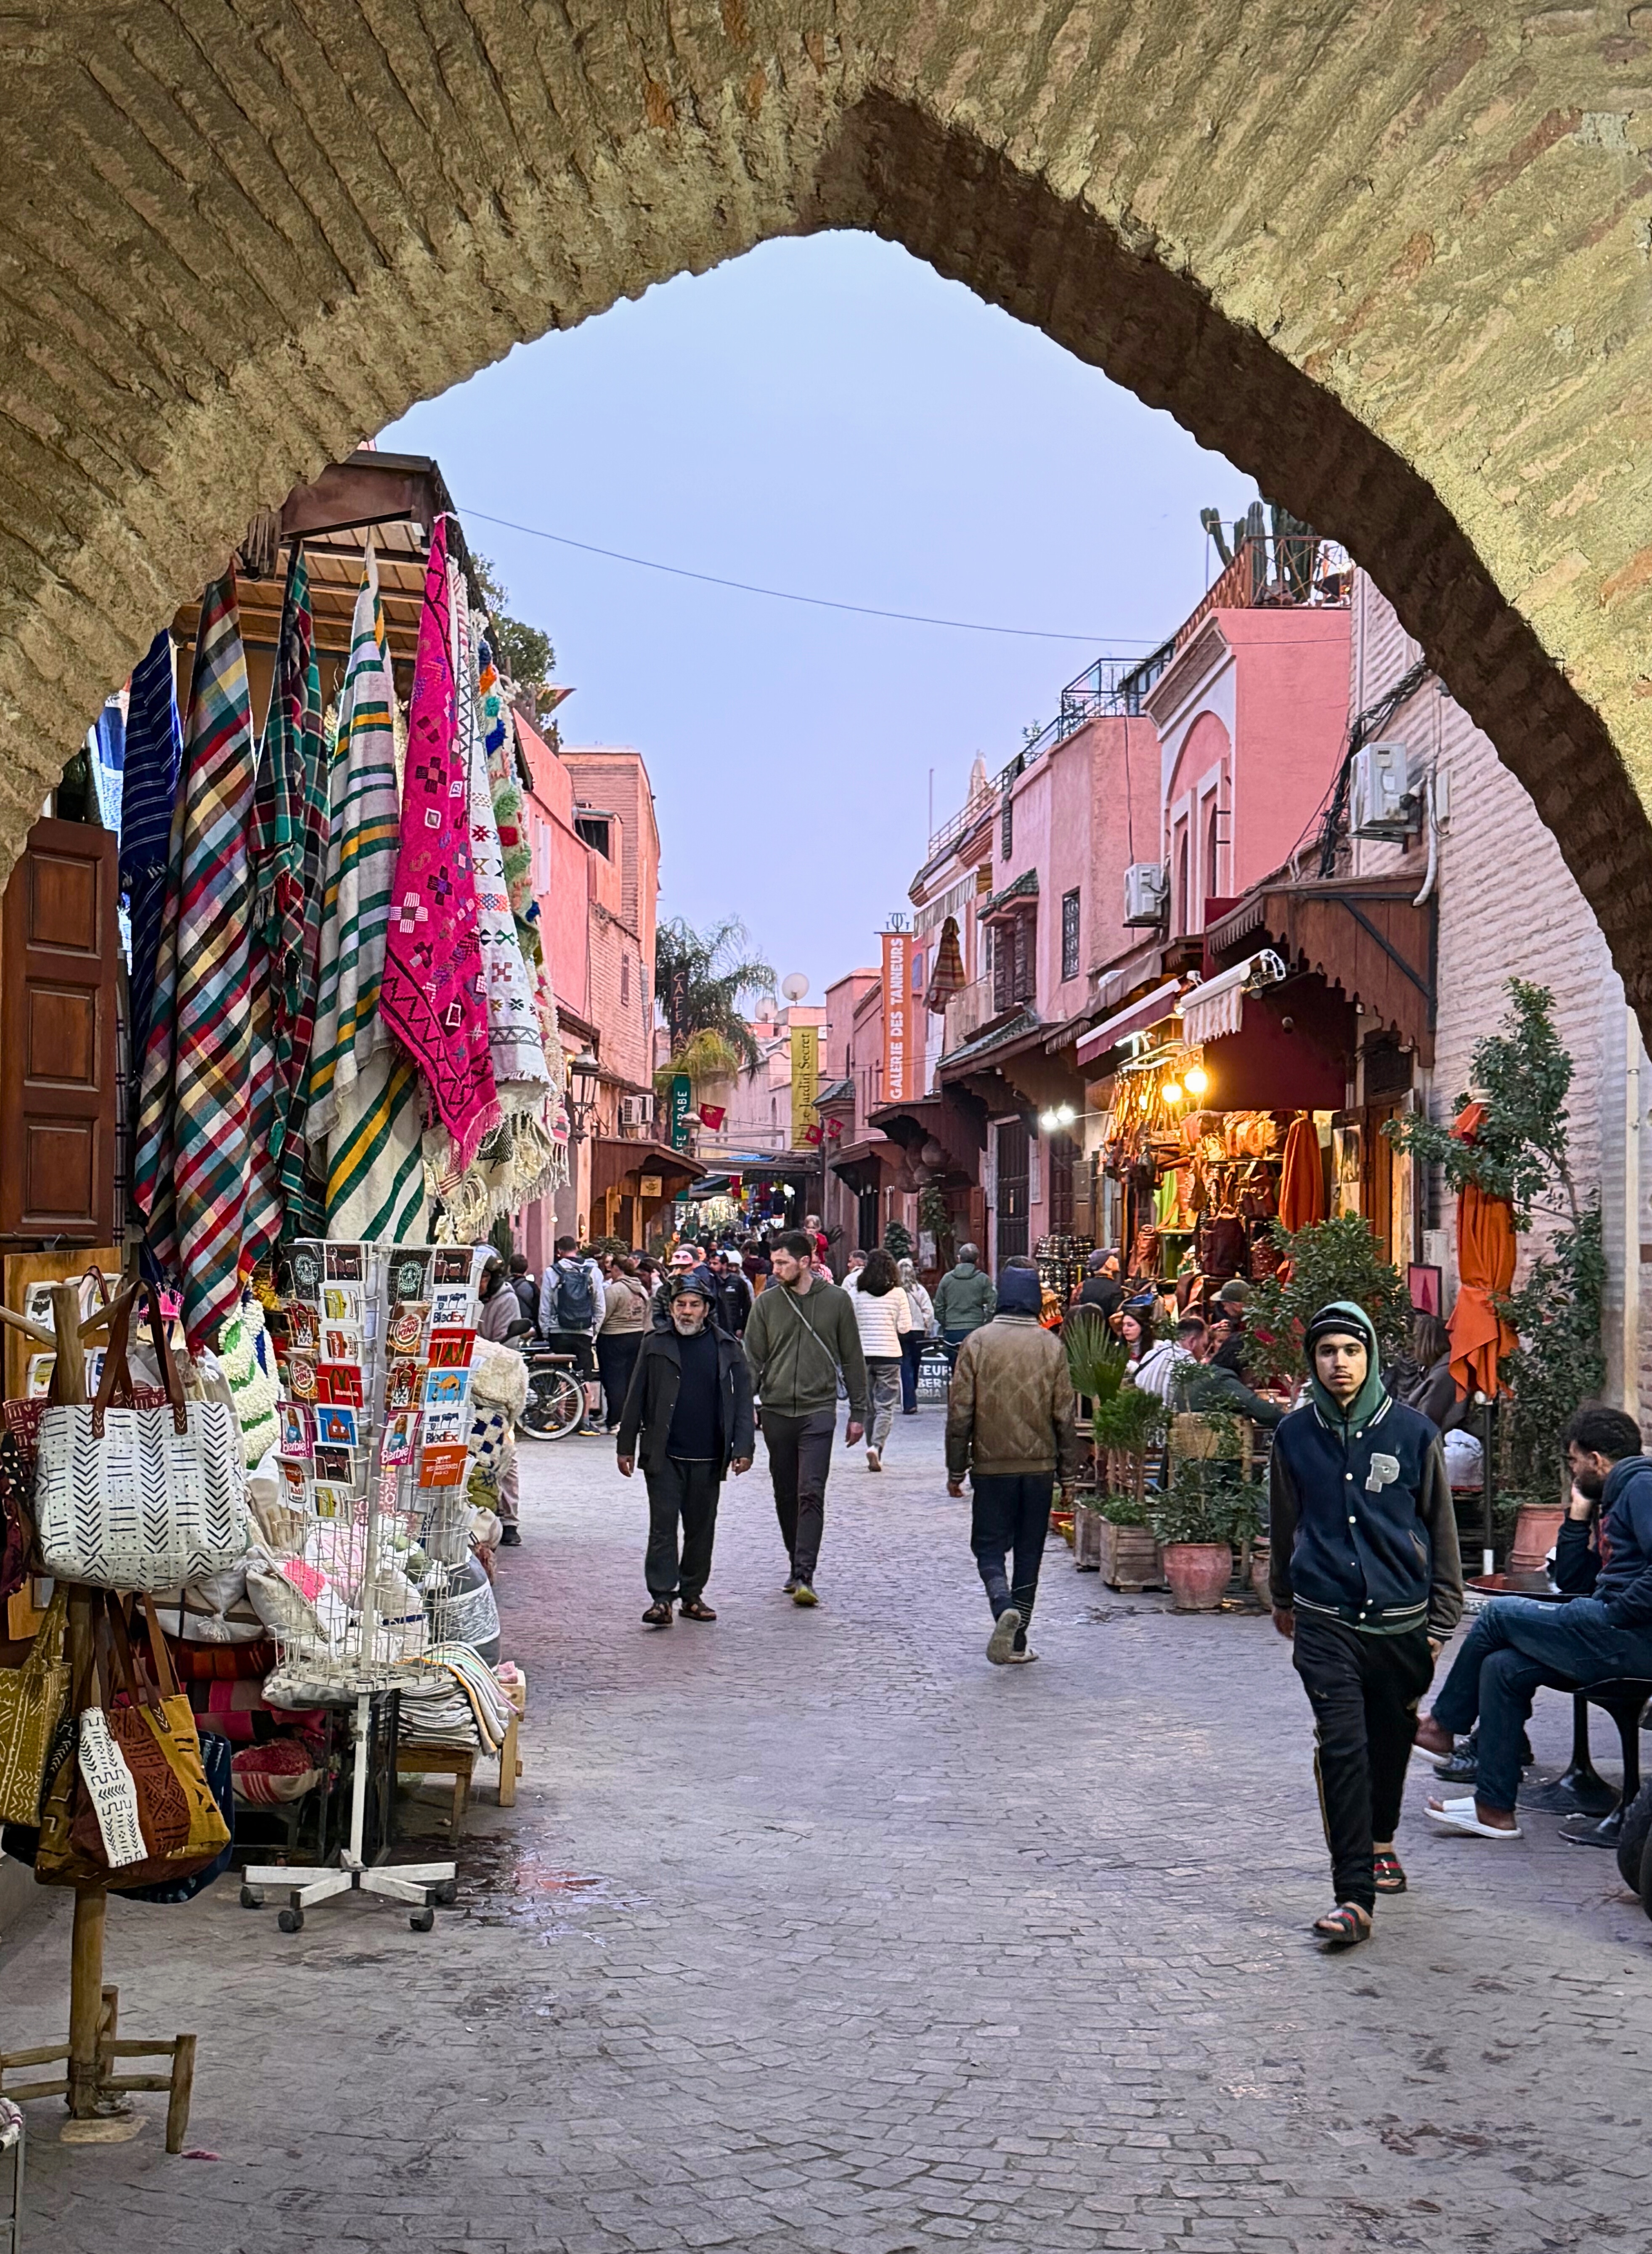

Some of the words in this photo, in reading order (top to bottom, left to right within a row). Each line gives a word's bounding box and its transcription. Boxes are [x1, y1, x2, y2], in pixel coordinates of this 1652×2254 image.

[890, 938, 904, 1005] TANNEURS
[890, 1011, 904, 1037] DES
[799, 1034, 810, 1069] Secret
[890, 1042, 903, 1099] GALERIE
[799, 1074, 813, 1109] Jardin
[1365, 1453, 1400, 1493] P
